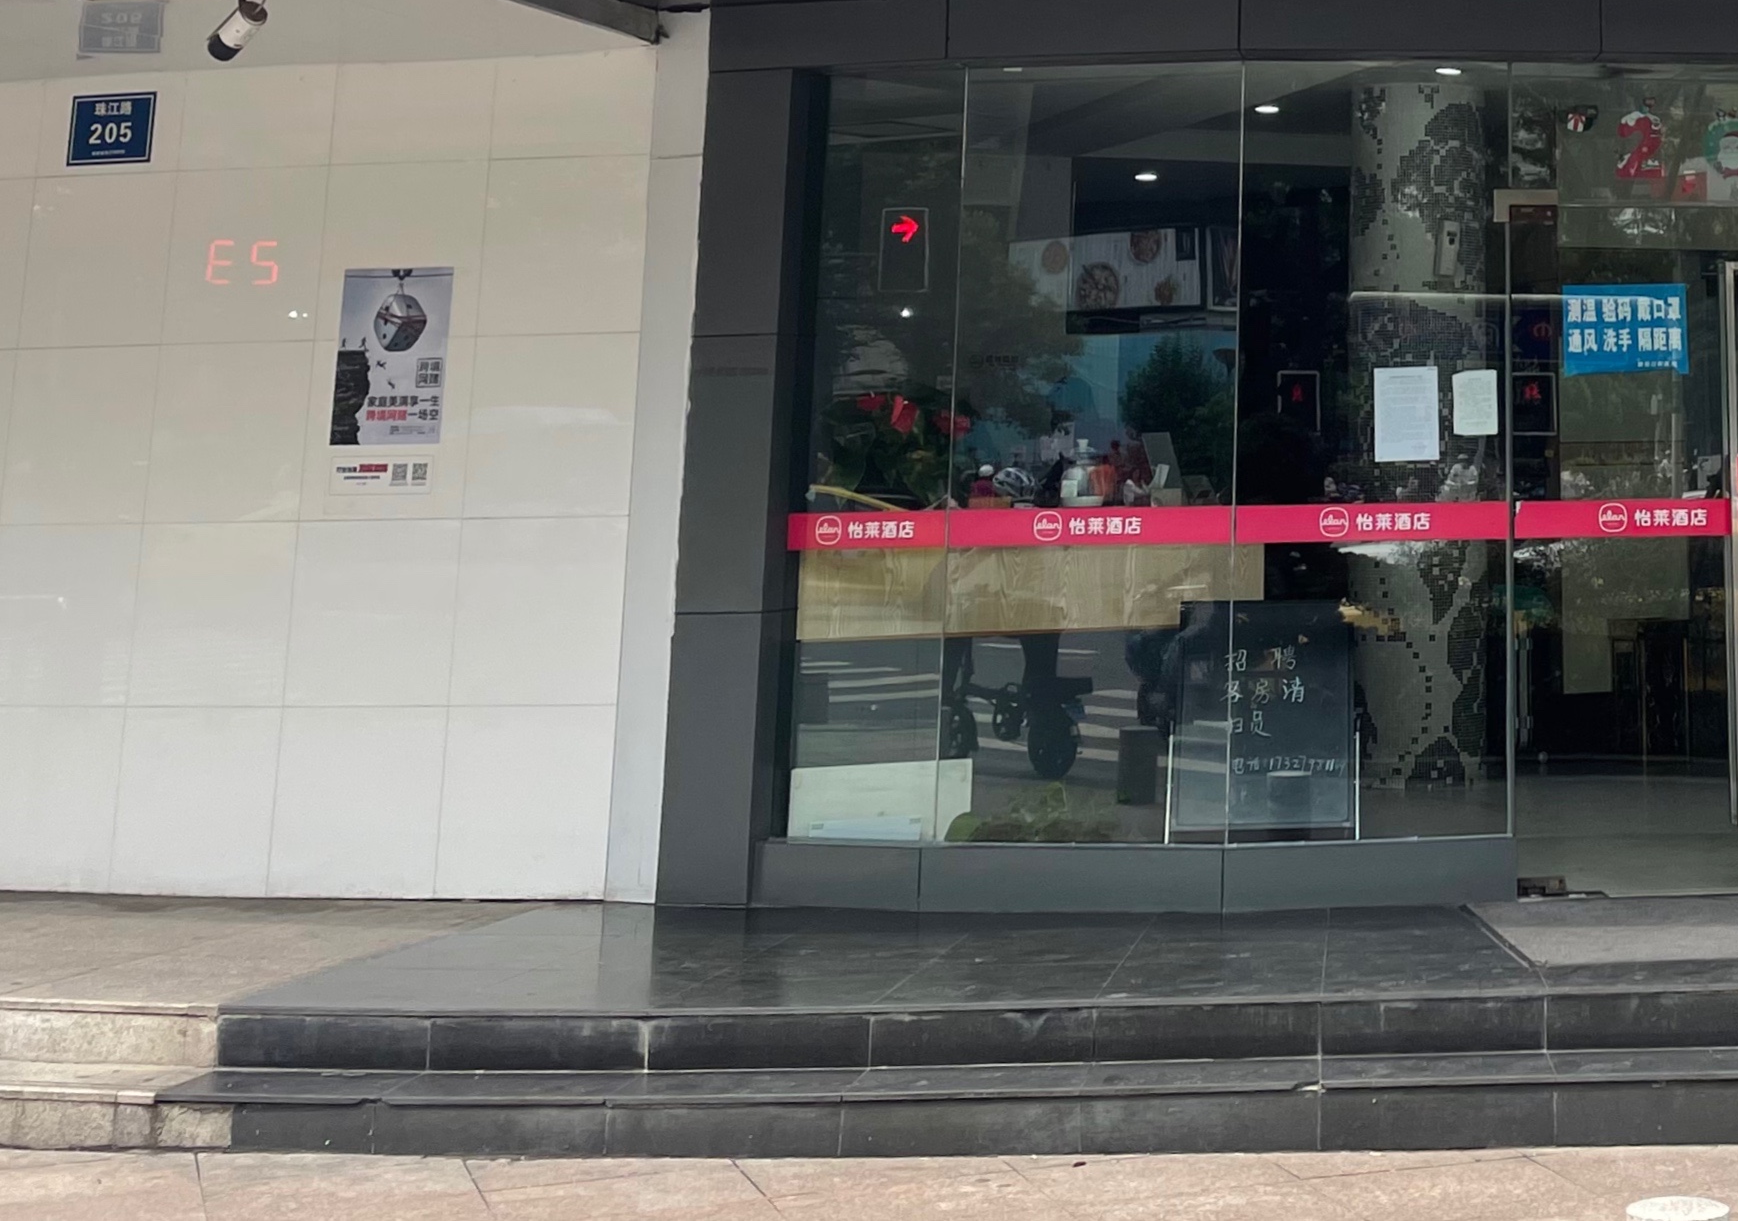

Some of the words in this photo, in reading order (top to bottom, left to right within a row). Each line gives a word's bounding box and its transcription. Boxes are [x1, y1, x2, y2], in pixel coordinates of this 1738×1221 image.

[94, 101, 132, 116] 珠江路
[89, 122, 132, 145] 205
[1567, 298, 1597, 323] 测温
[1602, 298, 1631, 322] 验码
[1637, 296, 1681, 321] 戴口罩
[1568, 328, 1598, 354] 通风
[1603, 327, 1632, 352] 洗手
[1638, 327, 1682, 352] 隔距离
[1069, 516, 1143, 536] 怡莱酒店
[1356, 512, 1431, 532] 怡莱酒店
[1634, 507, 1708, 528] 怡莱酒店
[847, 520, 915, 540] 怡莱酒店
[1224, 644, 1297, 672] 招聘
[1220, 676, 1305, 704] 客房清
